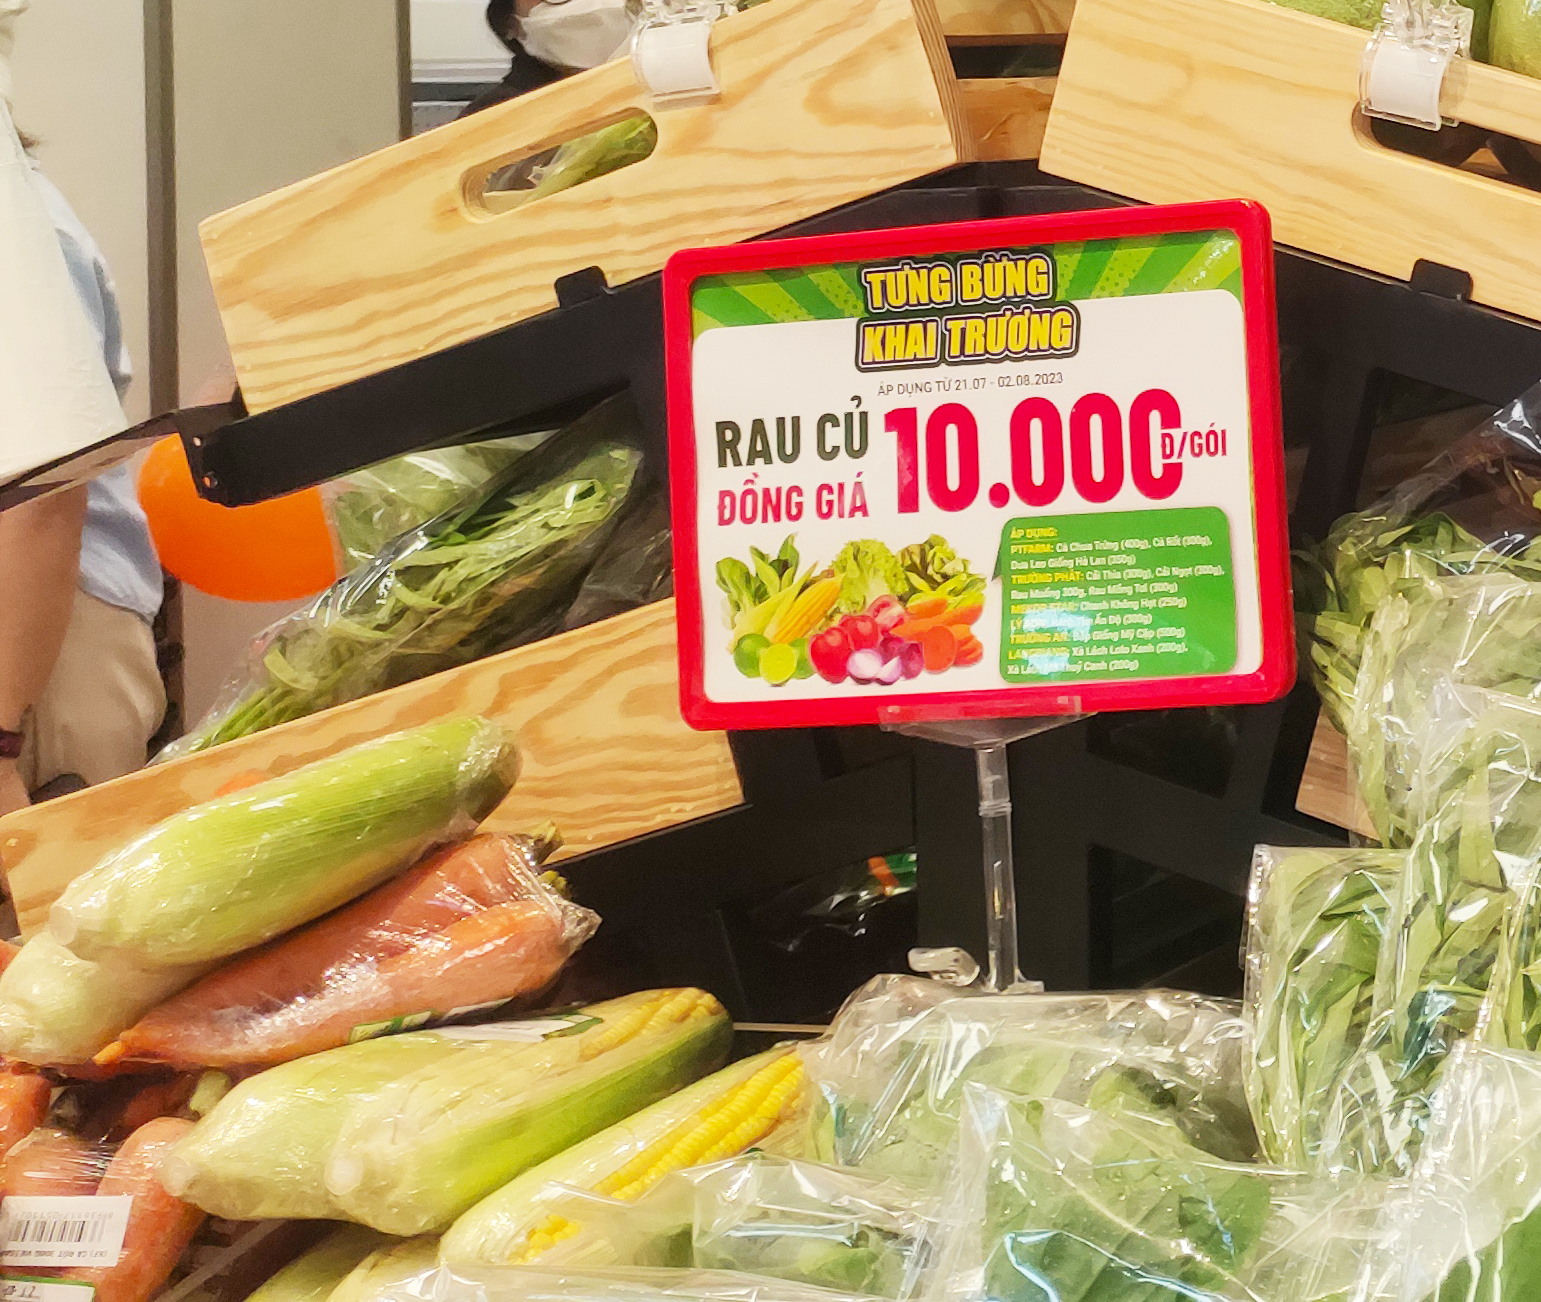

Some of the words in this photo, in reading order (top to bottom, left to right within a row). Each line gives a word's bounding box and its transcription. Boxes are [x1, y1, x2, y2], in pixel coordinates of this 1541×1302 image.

[866, 266, 951, 309] TƯNG
[961, 256, 1049, 301] BỪNG
[862, 321, 938, 363] KHAI
[947, 309, 1073, 357] TRƯƠNG
[878, 381, 894, 396] ÁP
[897, 381, 933, 398] DỤNG
[935, 376, 952, 392] TỪ
[955, 377, 987, 391] 21.07
[997, 372, 1064, 389] 02.08.2023
[715, 415, 801, 468] RAU
[816, 395, 869, 461] CỦ
[1161, 423, 1228, 461] Đ/GÓI
[717, 472, 804, 526] ĐỒNG
[815, 471, 869, 520] GIÁ
